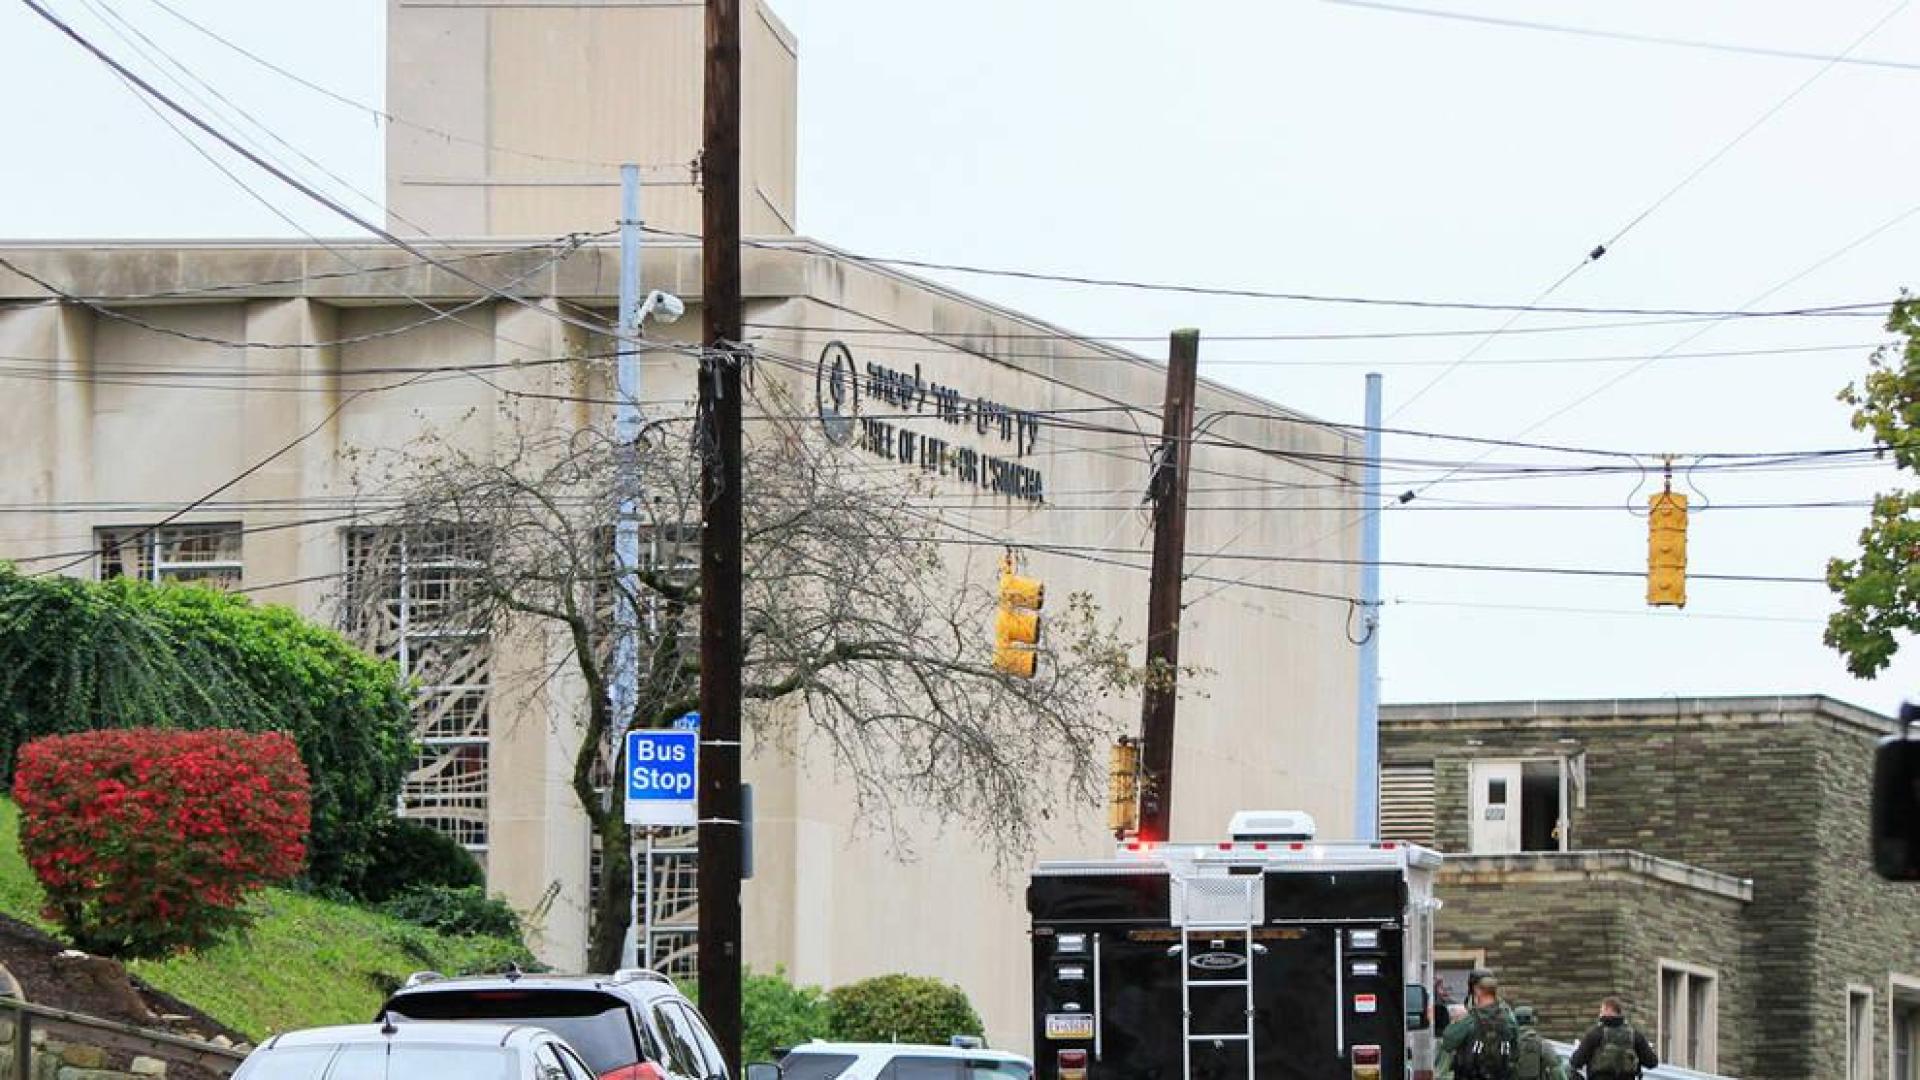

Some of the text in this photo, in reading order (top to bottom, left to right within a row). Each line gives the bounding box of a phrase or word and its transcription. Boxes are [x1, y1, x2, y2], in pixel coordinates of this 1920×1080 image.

[862, 416, 895, 460] TREE
[899, 429, 918, 464] OF
[920, 435, 949, 475] LIFE
[958, 448, 978, 484] OR
[637, 740, 686, 762] Bus
[632, 767, 692, 794] Stop
